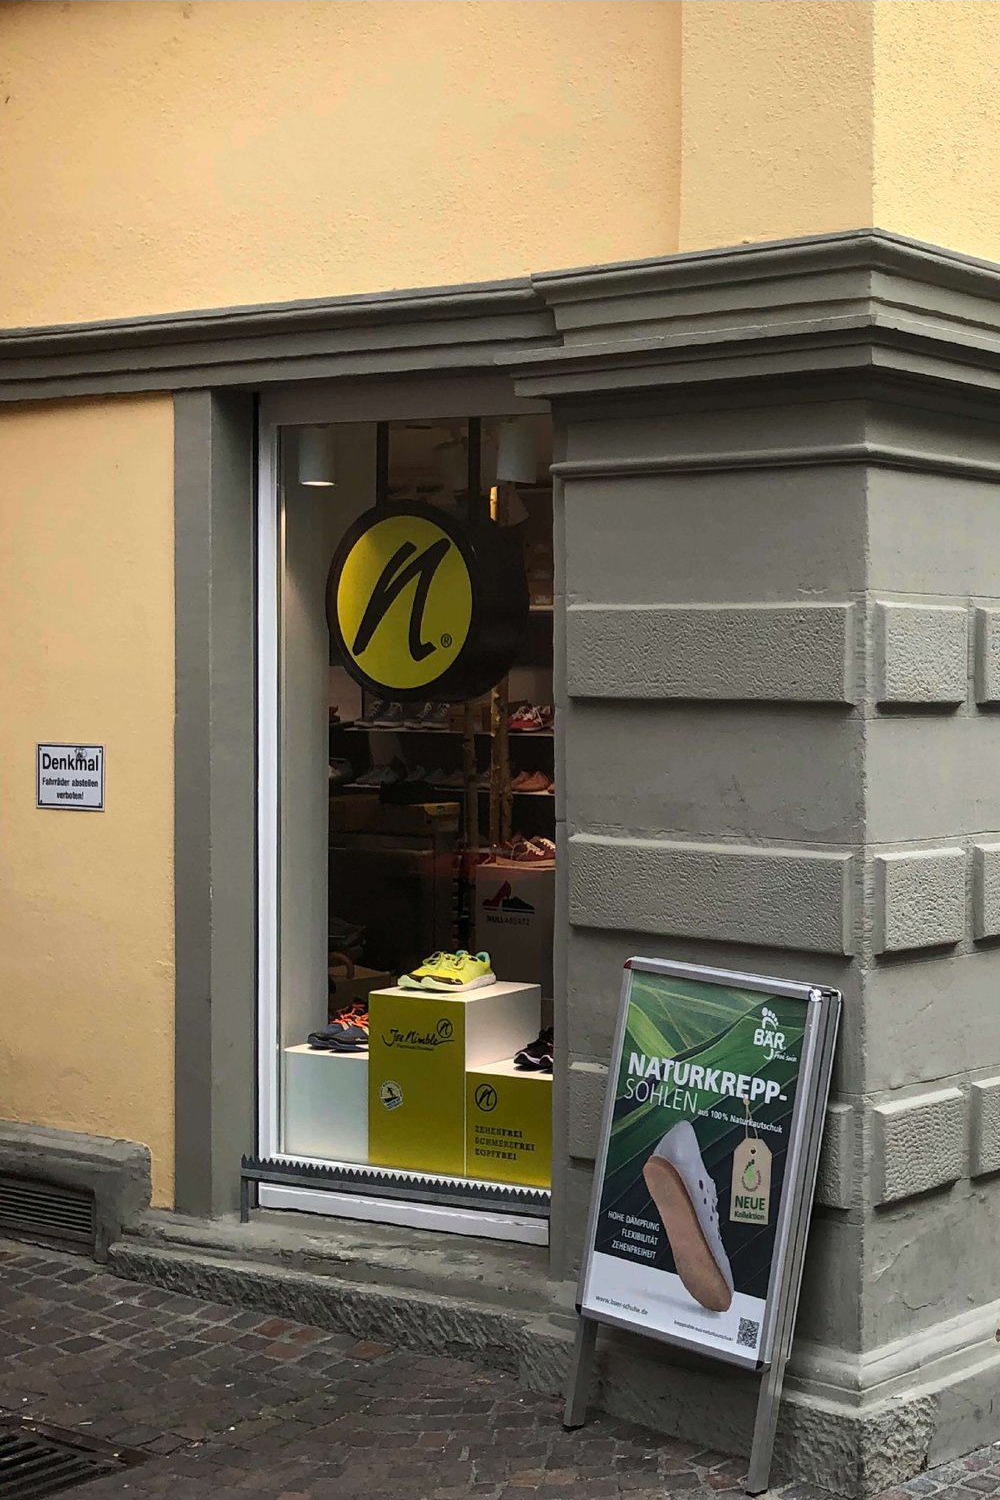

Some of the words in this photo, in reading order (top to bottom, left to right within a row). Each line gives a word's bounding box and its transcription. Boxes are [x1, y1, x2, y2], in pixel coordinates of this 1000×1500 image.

[42, 752, 99, 772] Denkmal
[42, 777, 70, 787] Fahrräder
[71, 778, 99, 788] abstellen
[56, 791, 84, 800] verboten!
[753, 1028, 785, 1050] BÄR
[628, 1052, 788, 1105] NATURKREPP-
[624, 1078, 698, 1114] SOHLEN
[474, 1124, 523, 1138] ZEHENFREI
[697, 1108, 710, 1118] aus
[711, 1110, 729, 1122] 100%
[730, 1115, 783, 1134] Naturkautschuk
[734, 1195, 766, 1211] NEUE
[608, 1210, 625, 1222] HOHE
[625, 1215, 660, 1232] DÄMPFUNG
[734, 1210, 765, 1221] Kollektion
[621, 1228, 659, 1246] FLEXIBILITÄT
[611, 1240, 657, 1260] ZEHENFREIHEIT
